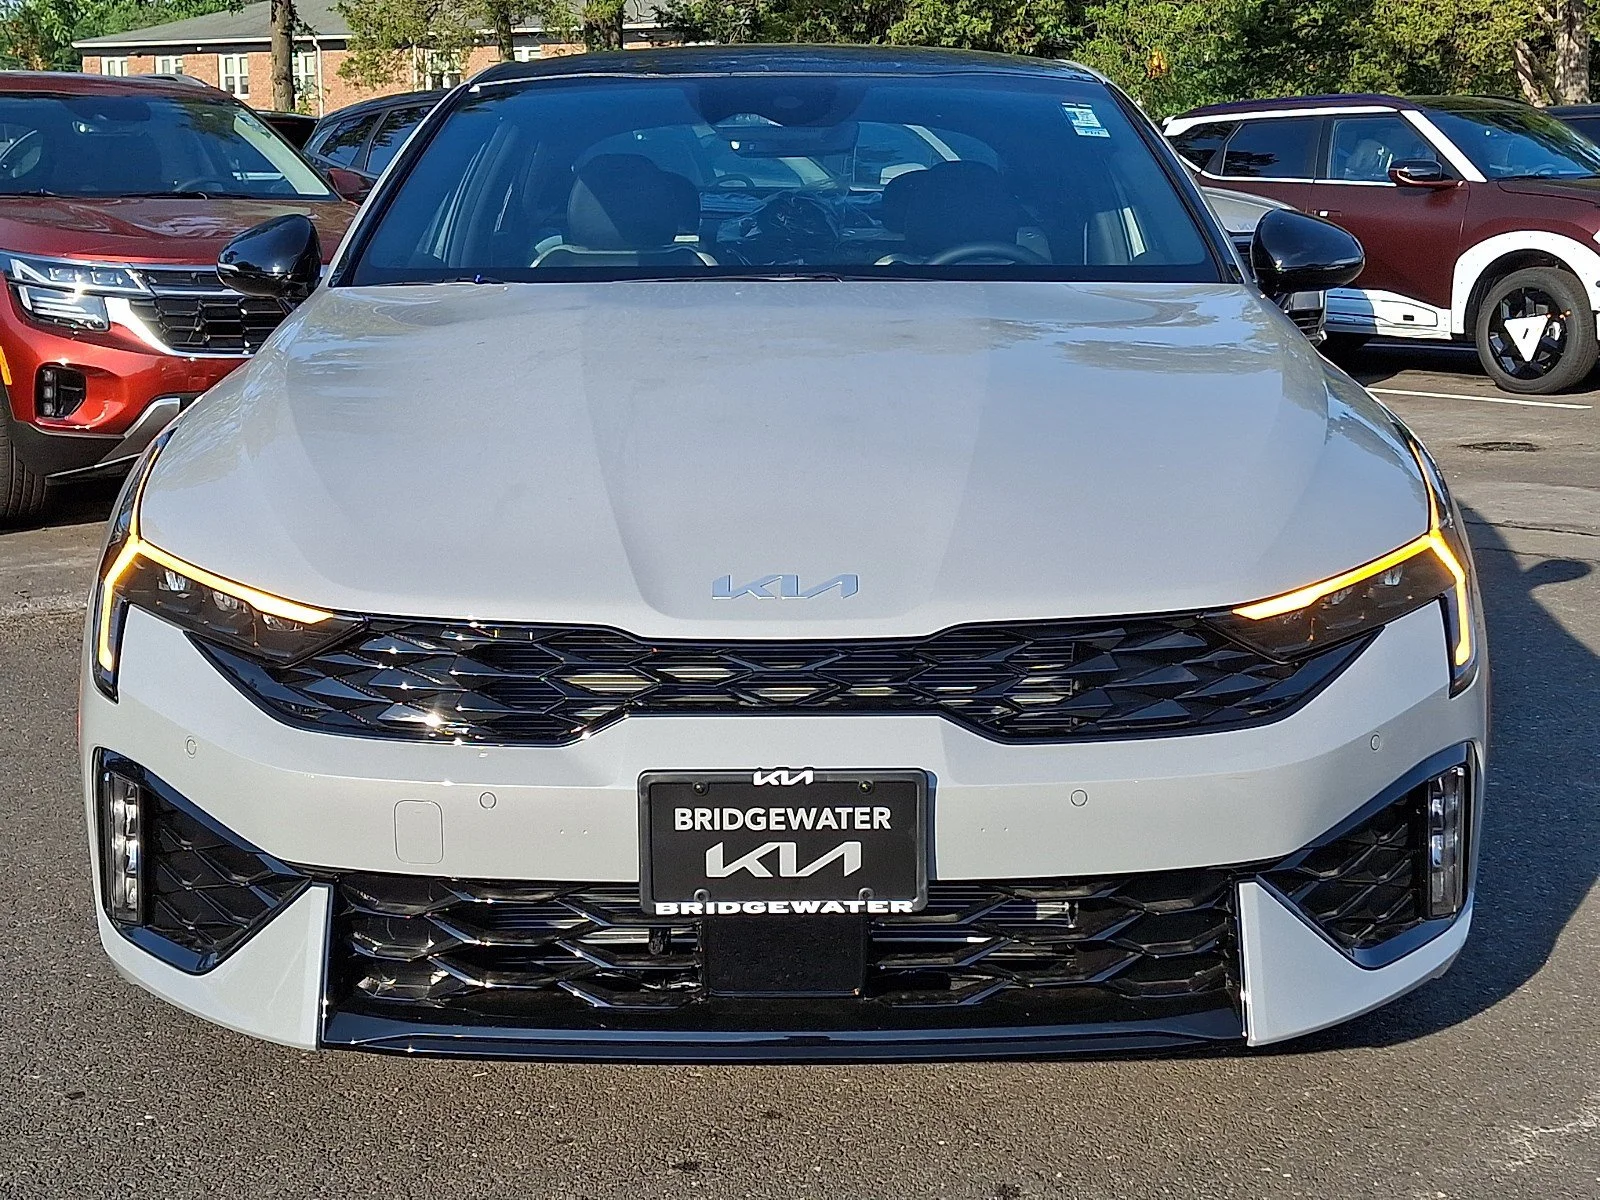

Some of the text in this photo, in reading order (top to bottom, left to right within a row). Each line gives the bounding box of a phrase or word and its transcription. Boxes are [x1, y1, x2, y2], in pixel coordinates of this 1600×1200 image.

[674, 807, 892, 832] BRIDGEWATER
[706, 842, 862, 878] KIA
[655, 900, 914, 916] BRIDGEWATER
